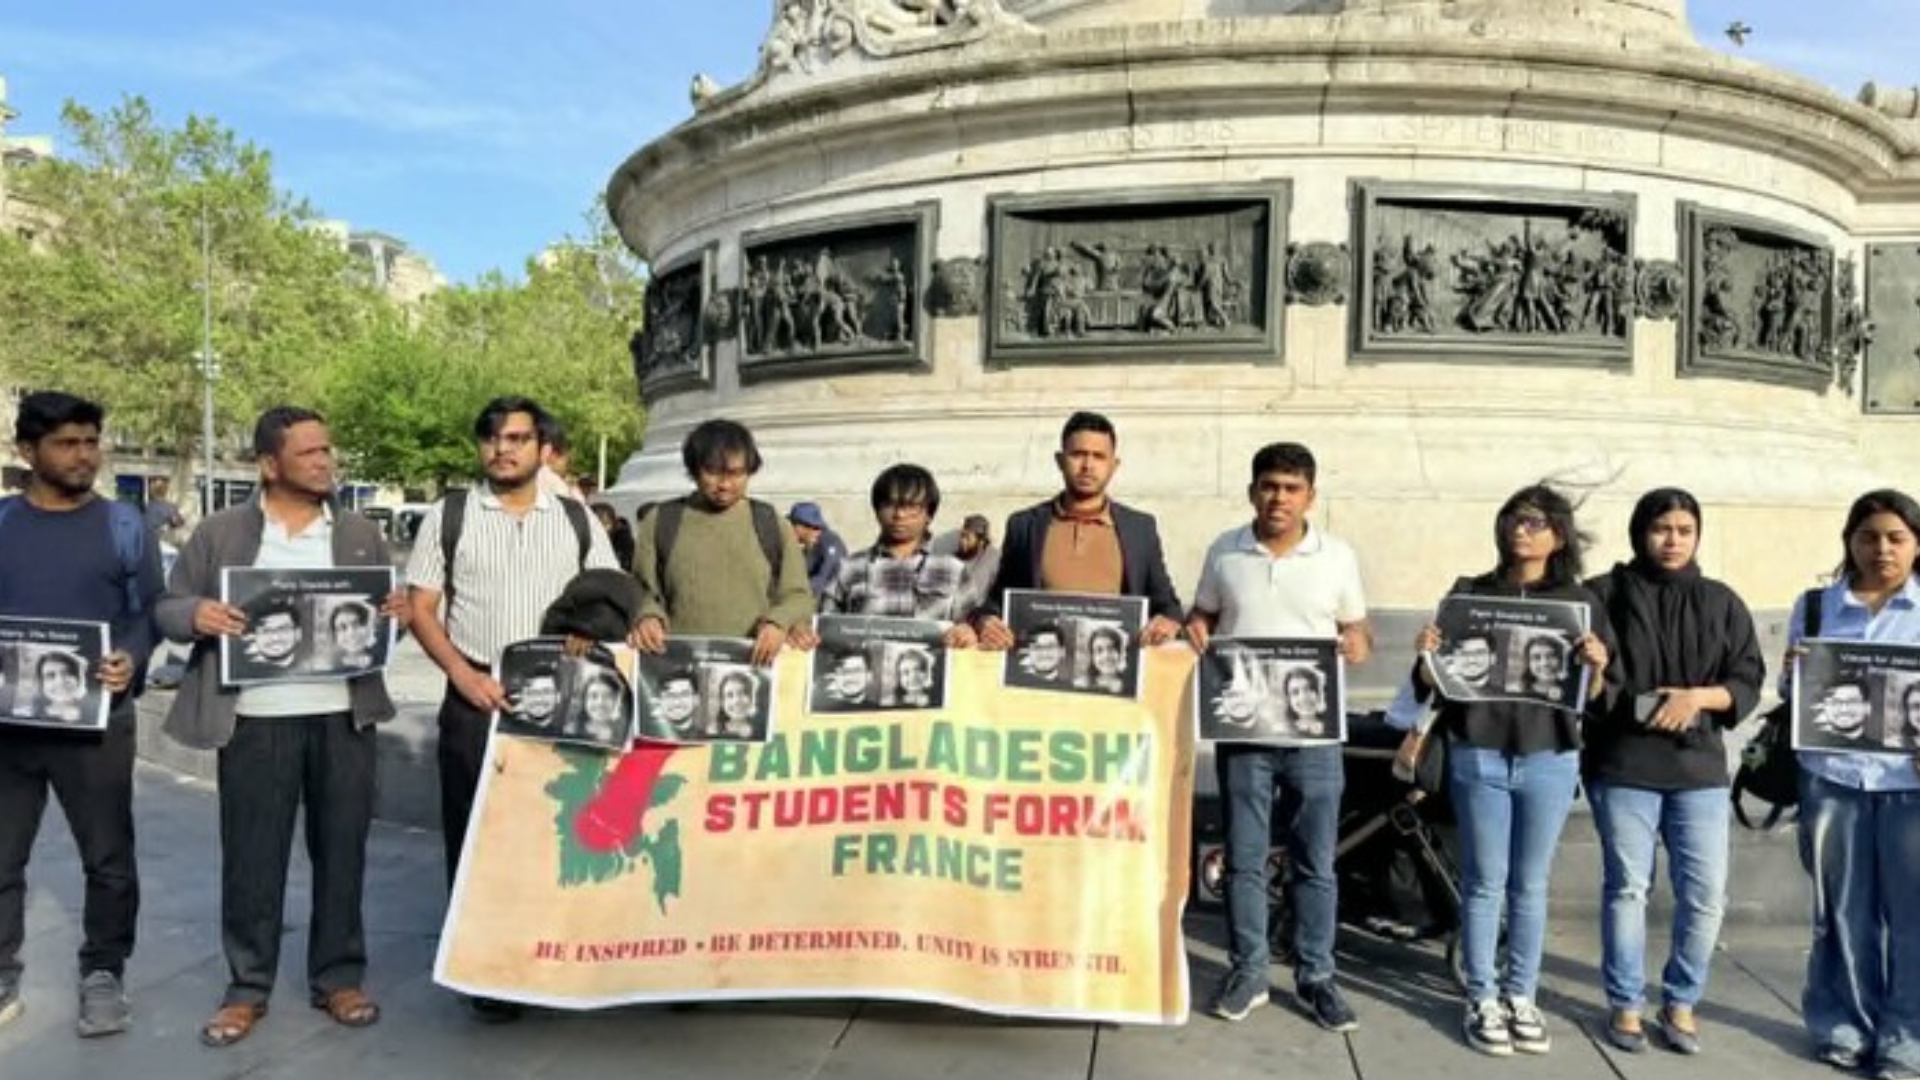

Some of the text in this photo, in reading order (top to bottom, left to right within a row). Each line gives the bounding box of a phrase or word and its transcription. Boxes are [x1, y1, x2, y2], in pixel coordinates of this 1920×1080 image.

[708, 721, 1151, 786] BANGLADESHI
[704, 780, 968, 832] STUDENTS
[832, 833, 1023, 891] FRANCE
[535, 941, 567, 961] BE
[576, 937, 687, 962] INSPIRED
[710, 934, 741, 952] BE
[916, 934, 977, 962] UNITY
[982, 945, 999, 966] IS
